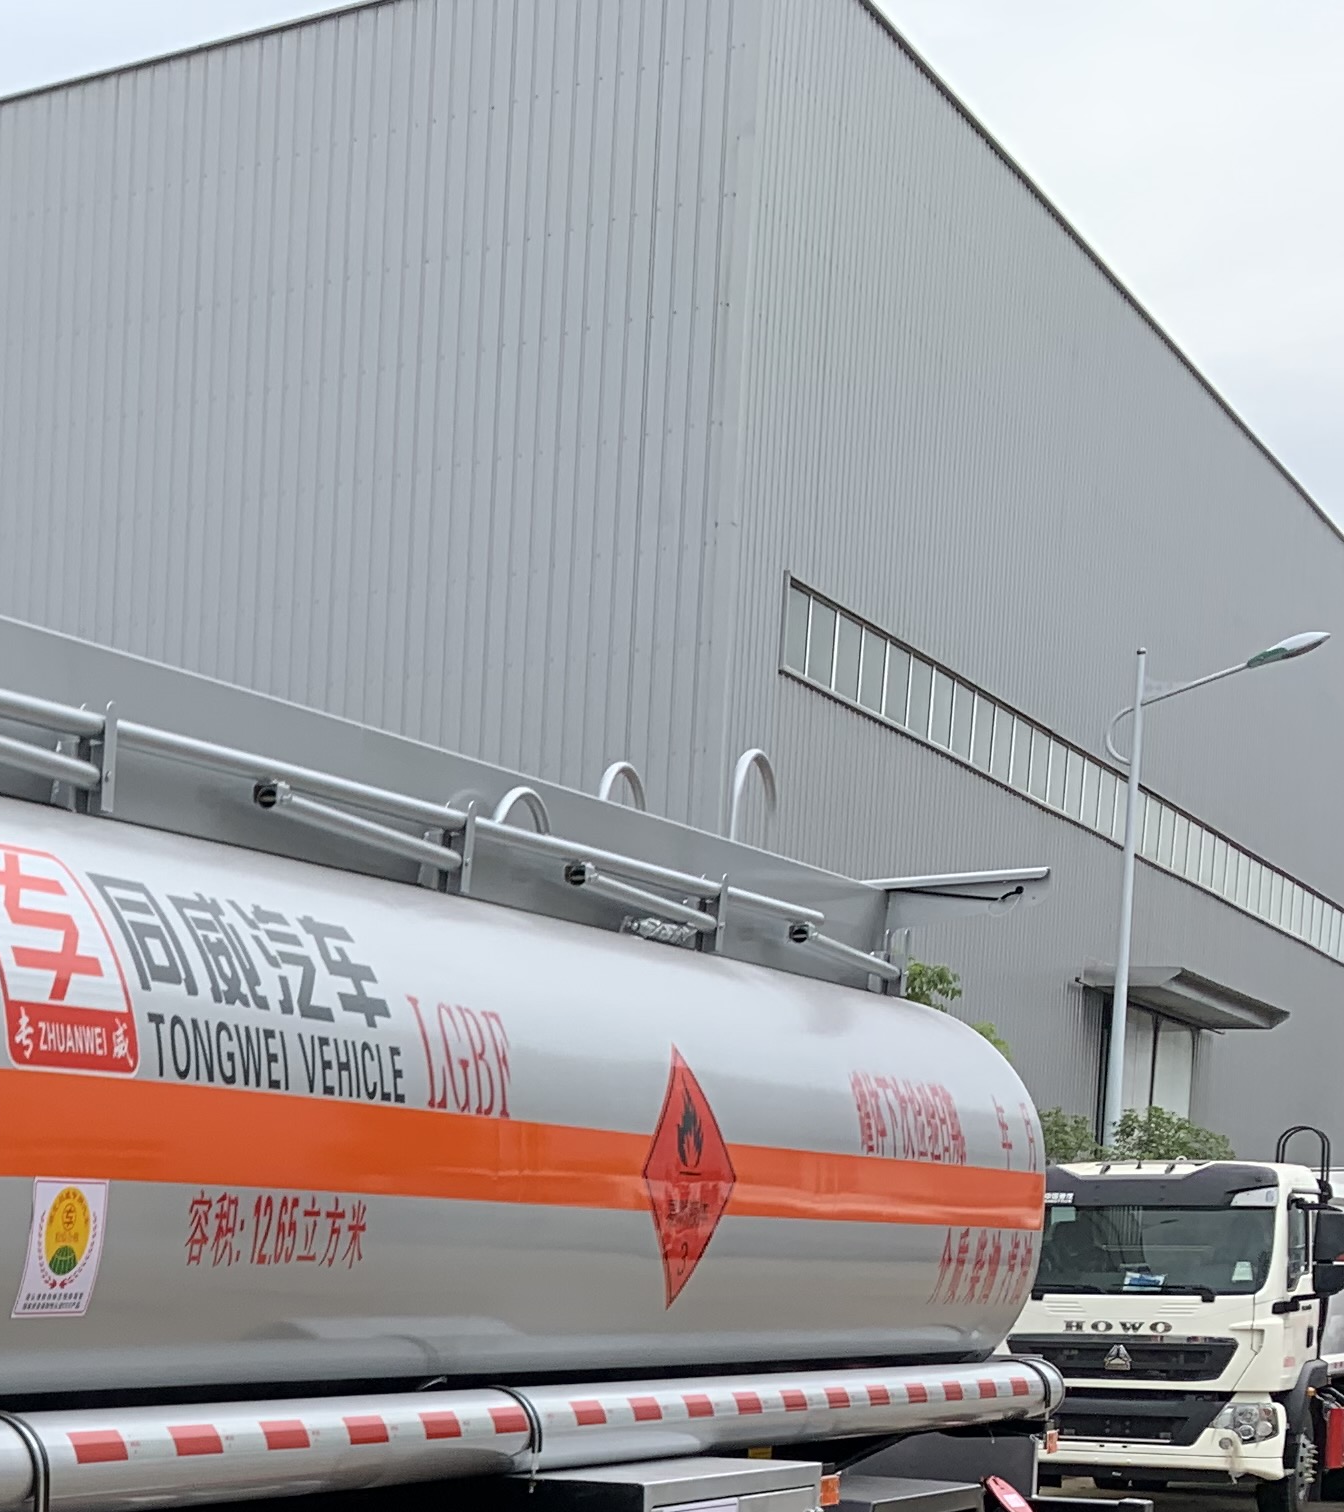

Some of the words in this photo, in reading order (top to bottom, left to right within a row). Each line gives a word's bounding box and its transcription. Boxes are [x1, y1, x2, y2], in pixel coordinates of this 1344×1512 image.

[84, 871, 392, 1028] 同威汽车
[38, 1020, 108, 1056] ZHUANWEI
[148, 1013, 290, 1091] TONGWEI
[298, 1033, 406, 1104] VEHICLE
[1063, 1320, 1172, 1334] HOWO
